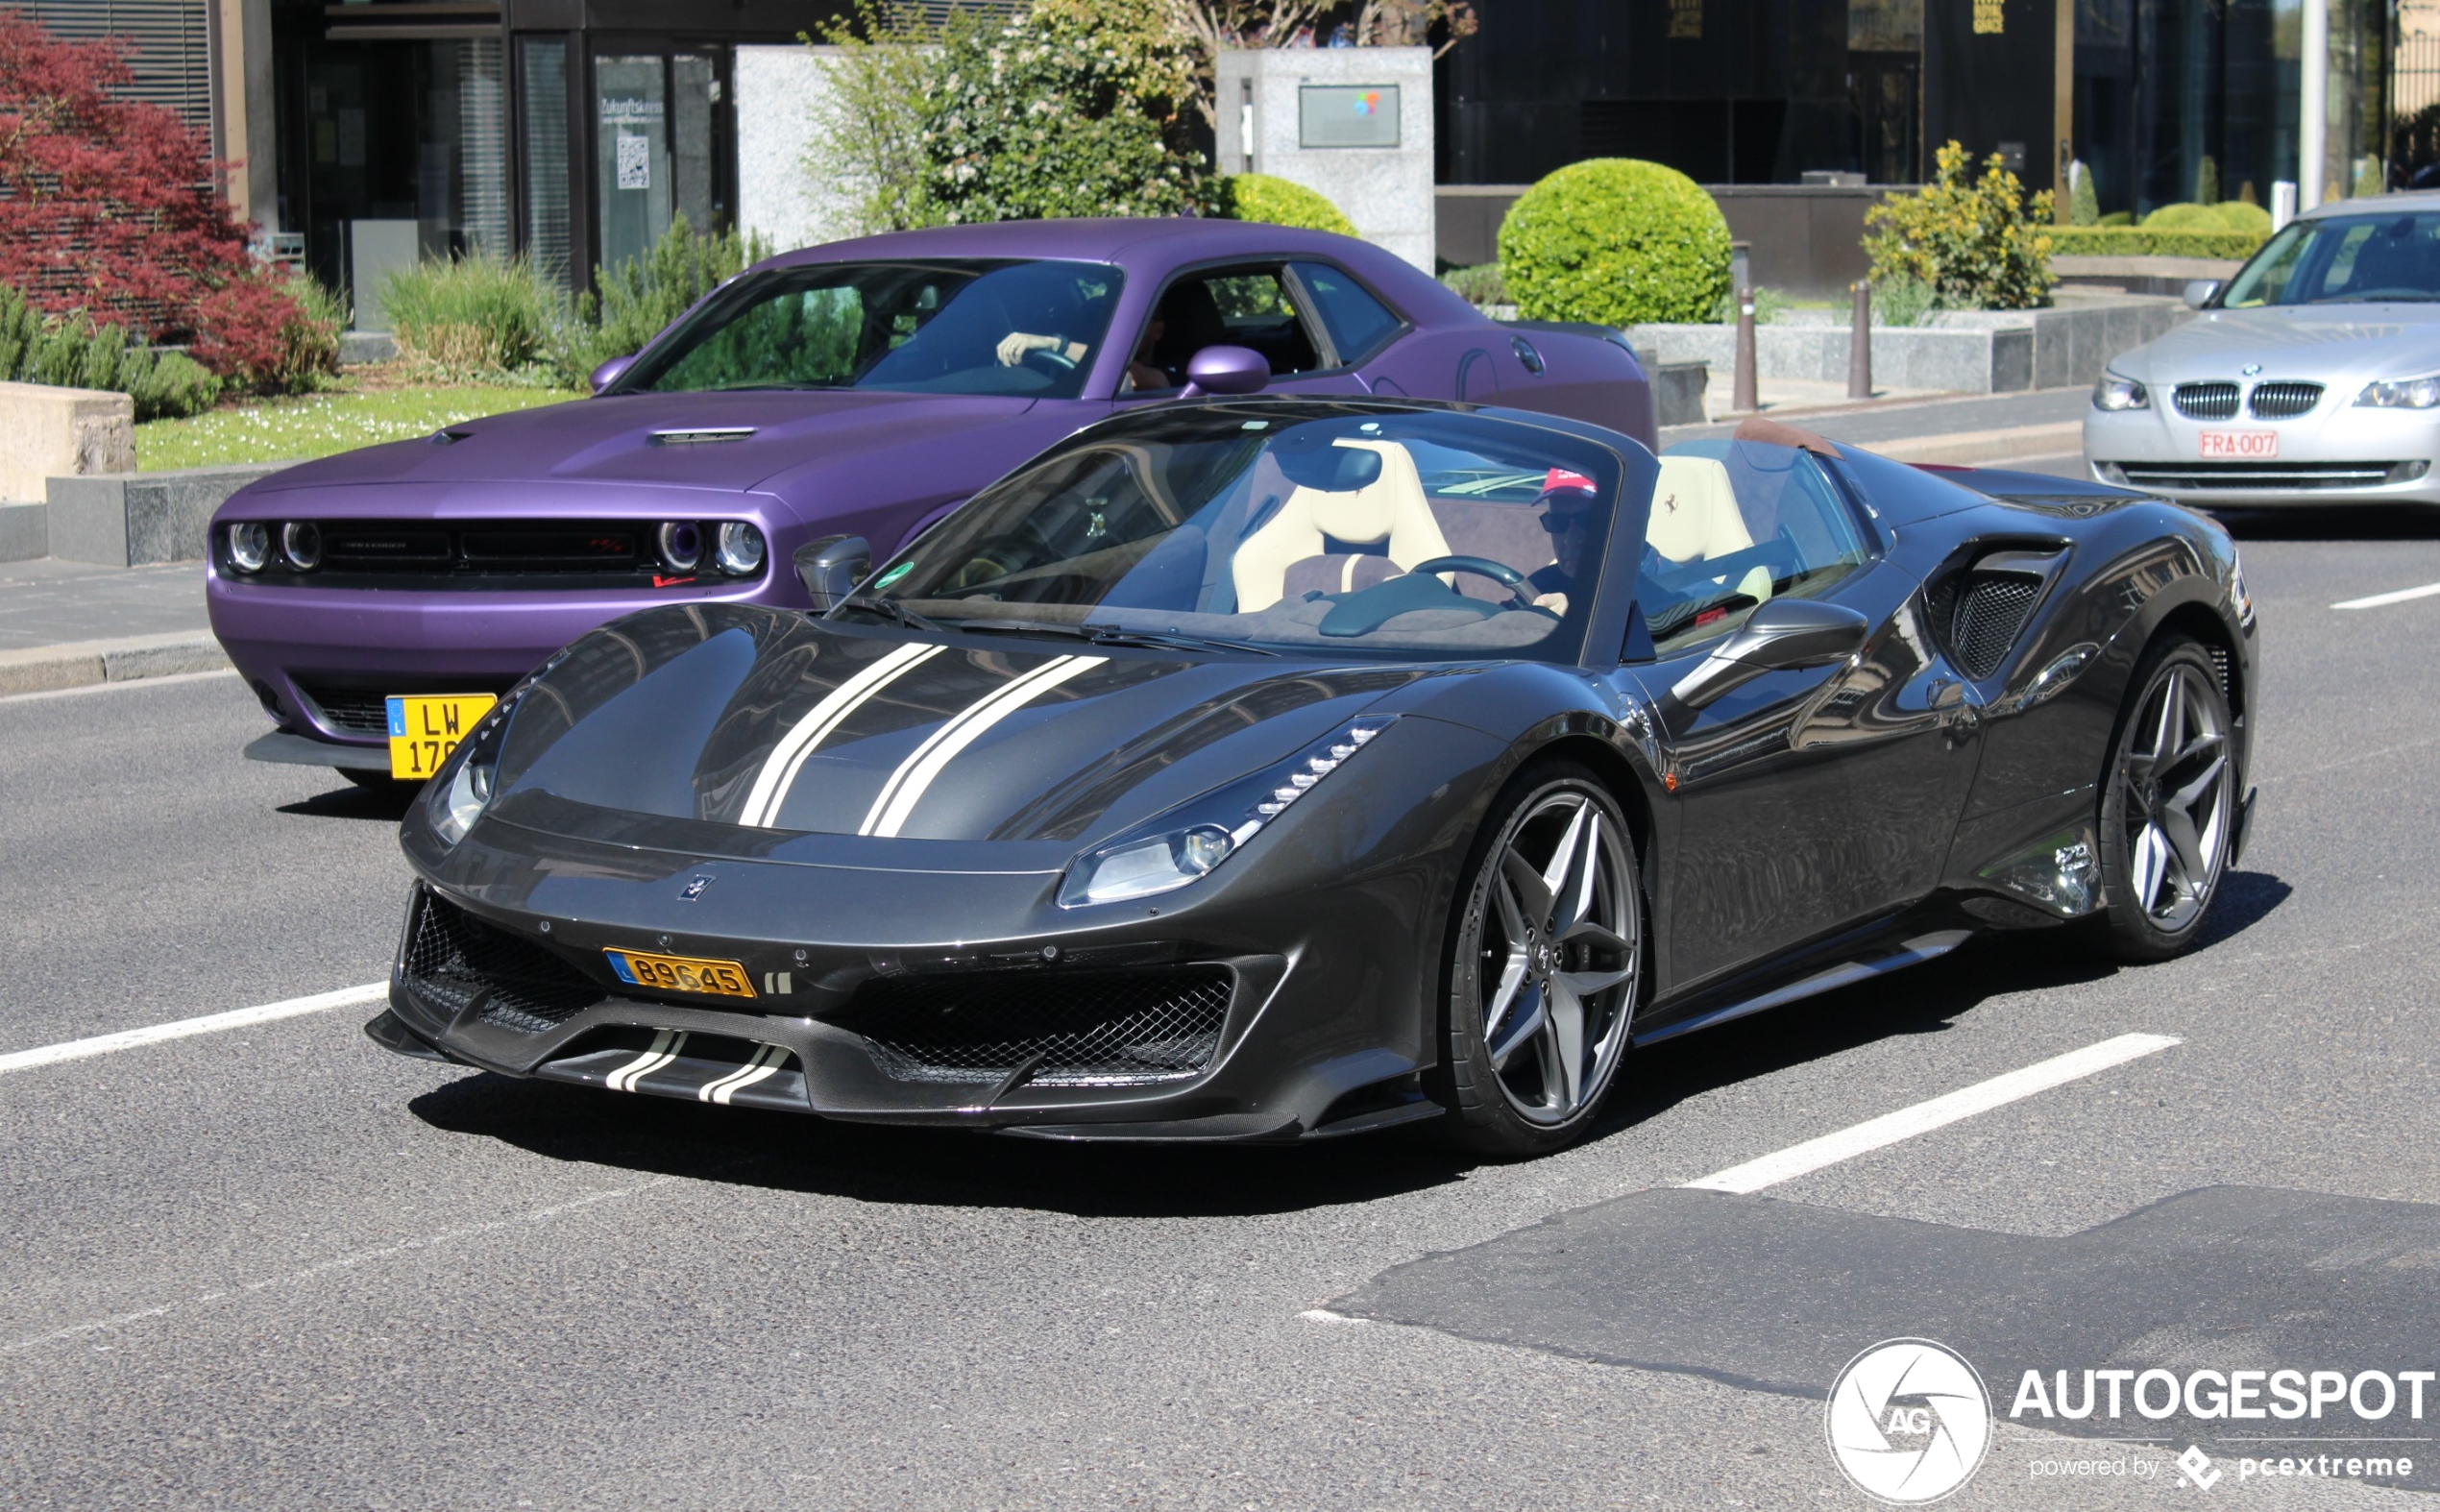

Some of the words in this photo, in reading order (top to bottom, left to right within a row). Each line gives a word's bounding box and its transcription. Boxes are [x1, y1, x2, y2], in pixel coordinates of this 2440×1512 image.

[395, 721, 401, 734] L
[423, 703, 459, 736] LW
[635, 960, 742, 992] 89645
